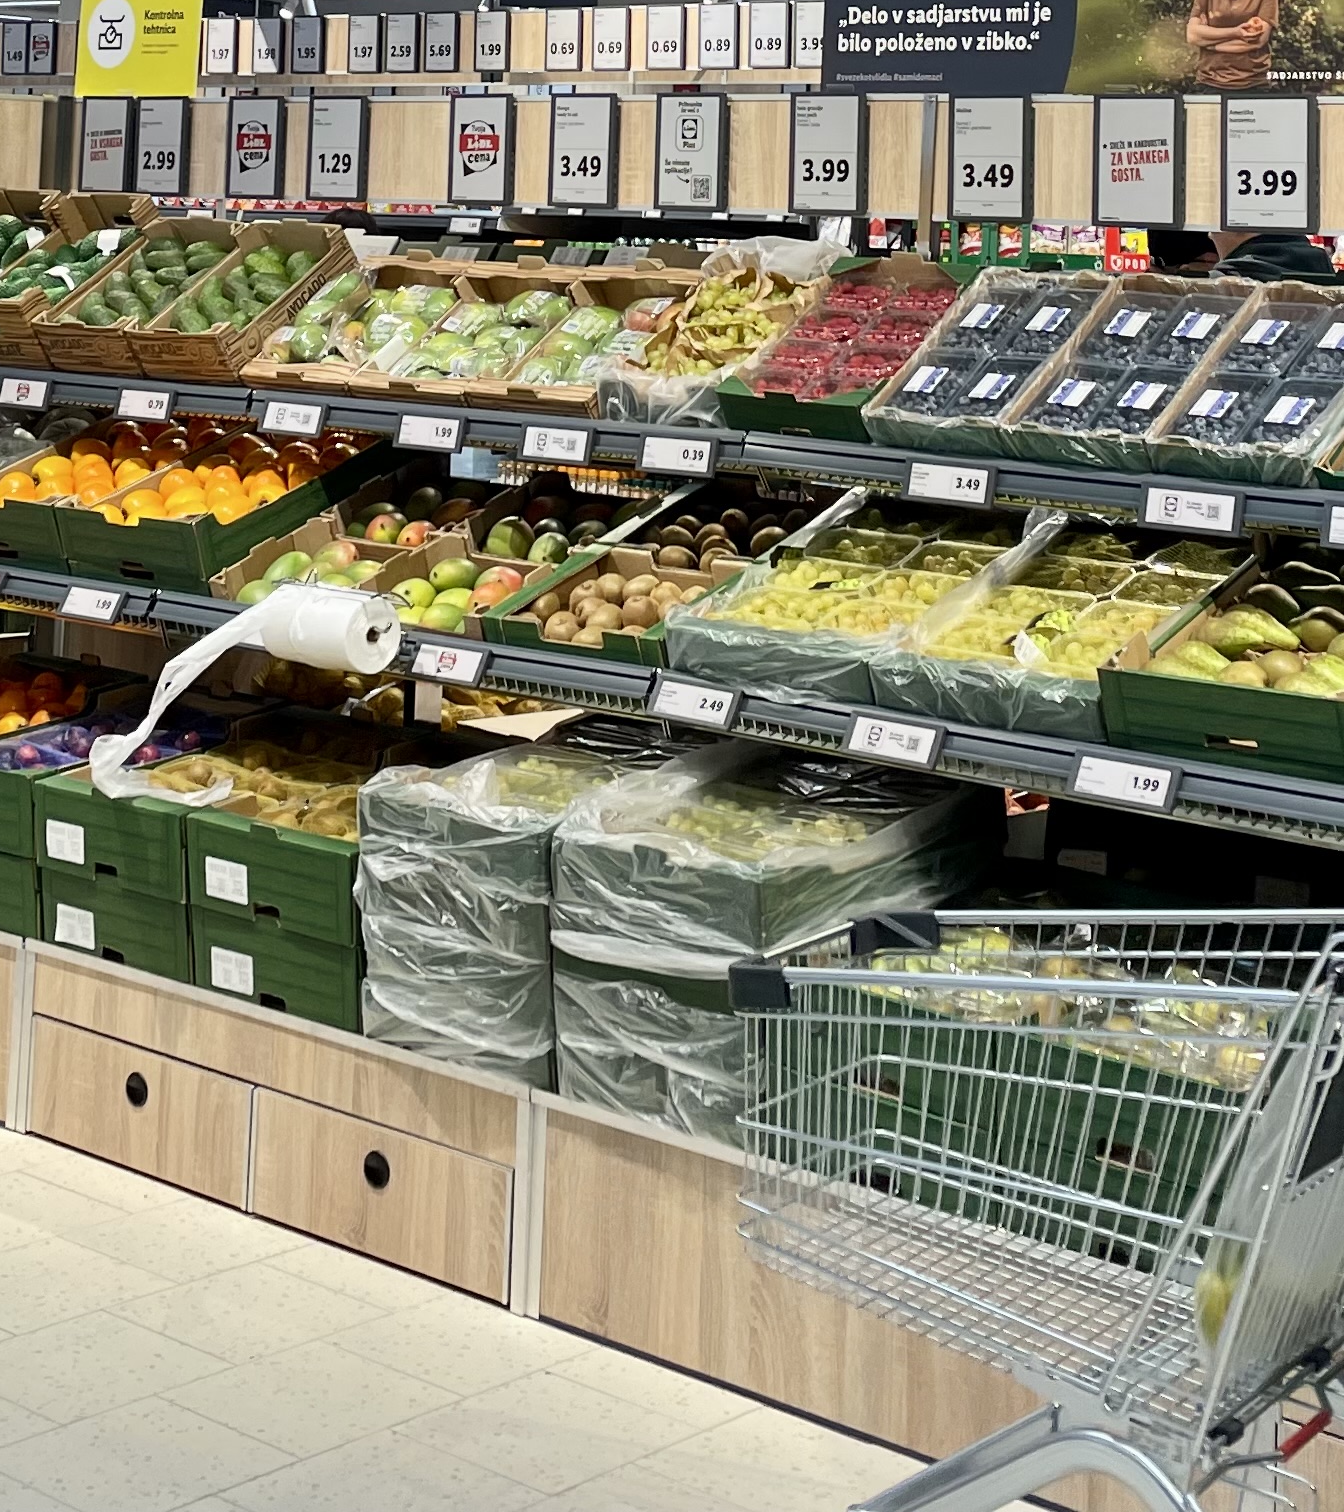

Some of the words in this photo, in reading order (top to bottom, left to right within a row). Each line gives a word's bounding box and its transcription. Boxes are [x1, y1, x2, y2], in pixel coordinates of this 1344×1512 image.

[144, 9, 185, 20] Kontrolna
[892, 9, 903, 24] v
[906, 3, 1001, 28] sadjarstvu
[1005, 1, 1030, 23] mi
[1033, 0, 1052, 29] je
[143, 22, 176, 35] tehtnica
[390, 45, 412, 58] 2.59
[429, 44, 452, 58] 5.69
[480, 44, 502, 56] 1.99
[550, 42, 575, 55] 0.69
[597, 40, 623, 54] 0.69
[651, 40, 678, 54] 0.69
[704, 38, 731, 53] 0.89
[755, 37, 782, 52] 0.89
[837, 32, 872, 52] bilo
[875, 32, 958, 57] položeno
[961, 36, 973, 51] v
[7, 50, 23, 62] 1.49
[211, 49, 229, 60] 1.97
[297, 47, 316, 59] 1.95
[353, 46, 373, 59] 1.97
[1266, 71, 1333, 81] SADJARSTVO
[143, 151, 176, 170] 2.99
[243, 150, 263, 162] cena
[467, 151, 491, 164] cena
[1111, 152, 1123, 166] ZA
[1126, 149, 1170, 165] VSAKEGA
[317, 153, 352, 175] 1.29
[560, 154, 602, 178] 3.49
[802, 159, 850, 182] 3.99
[962, 163, 1014, 188] 3.49
[1237, 169, 1298, 196] 3.99
[286, 273, 327, 321] AVOCADO
[435, 426, 453, 438] 1.99
[682, 449, 704, 461] 0.39
[955, 477, 980, 491] 3.49
[96, 598, 112, 610] 1.99
[699, 698, 724, 713] 2.49
[1133, 776, 1160, 792] 1.99
